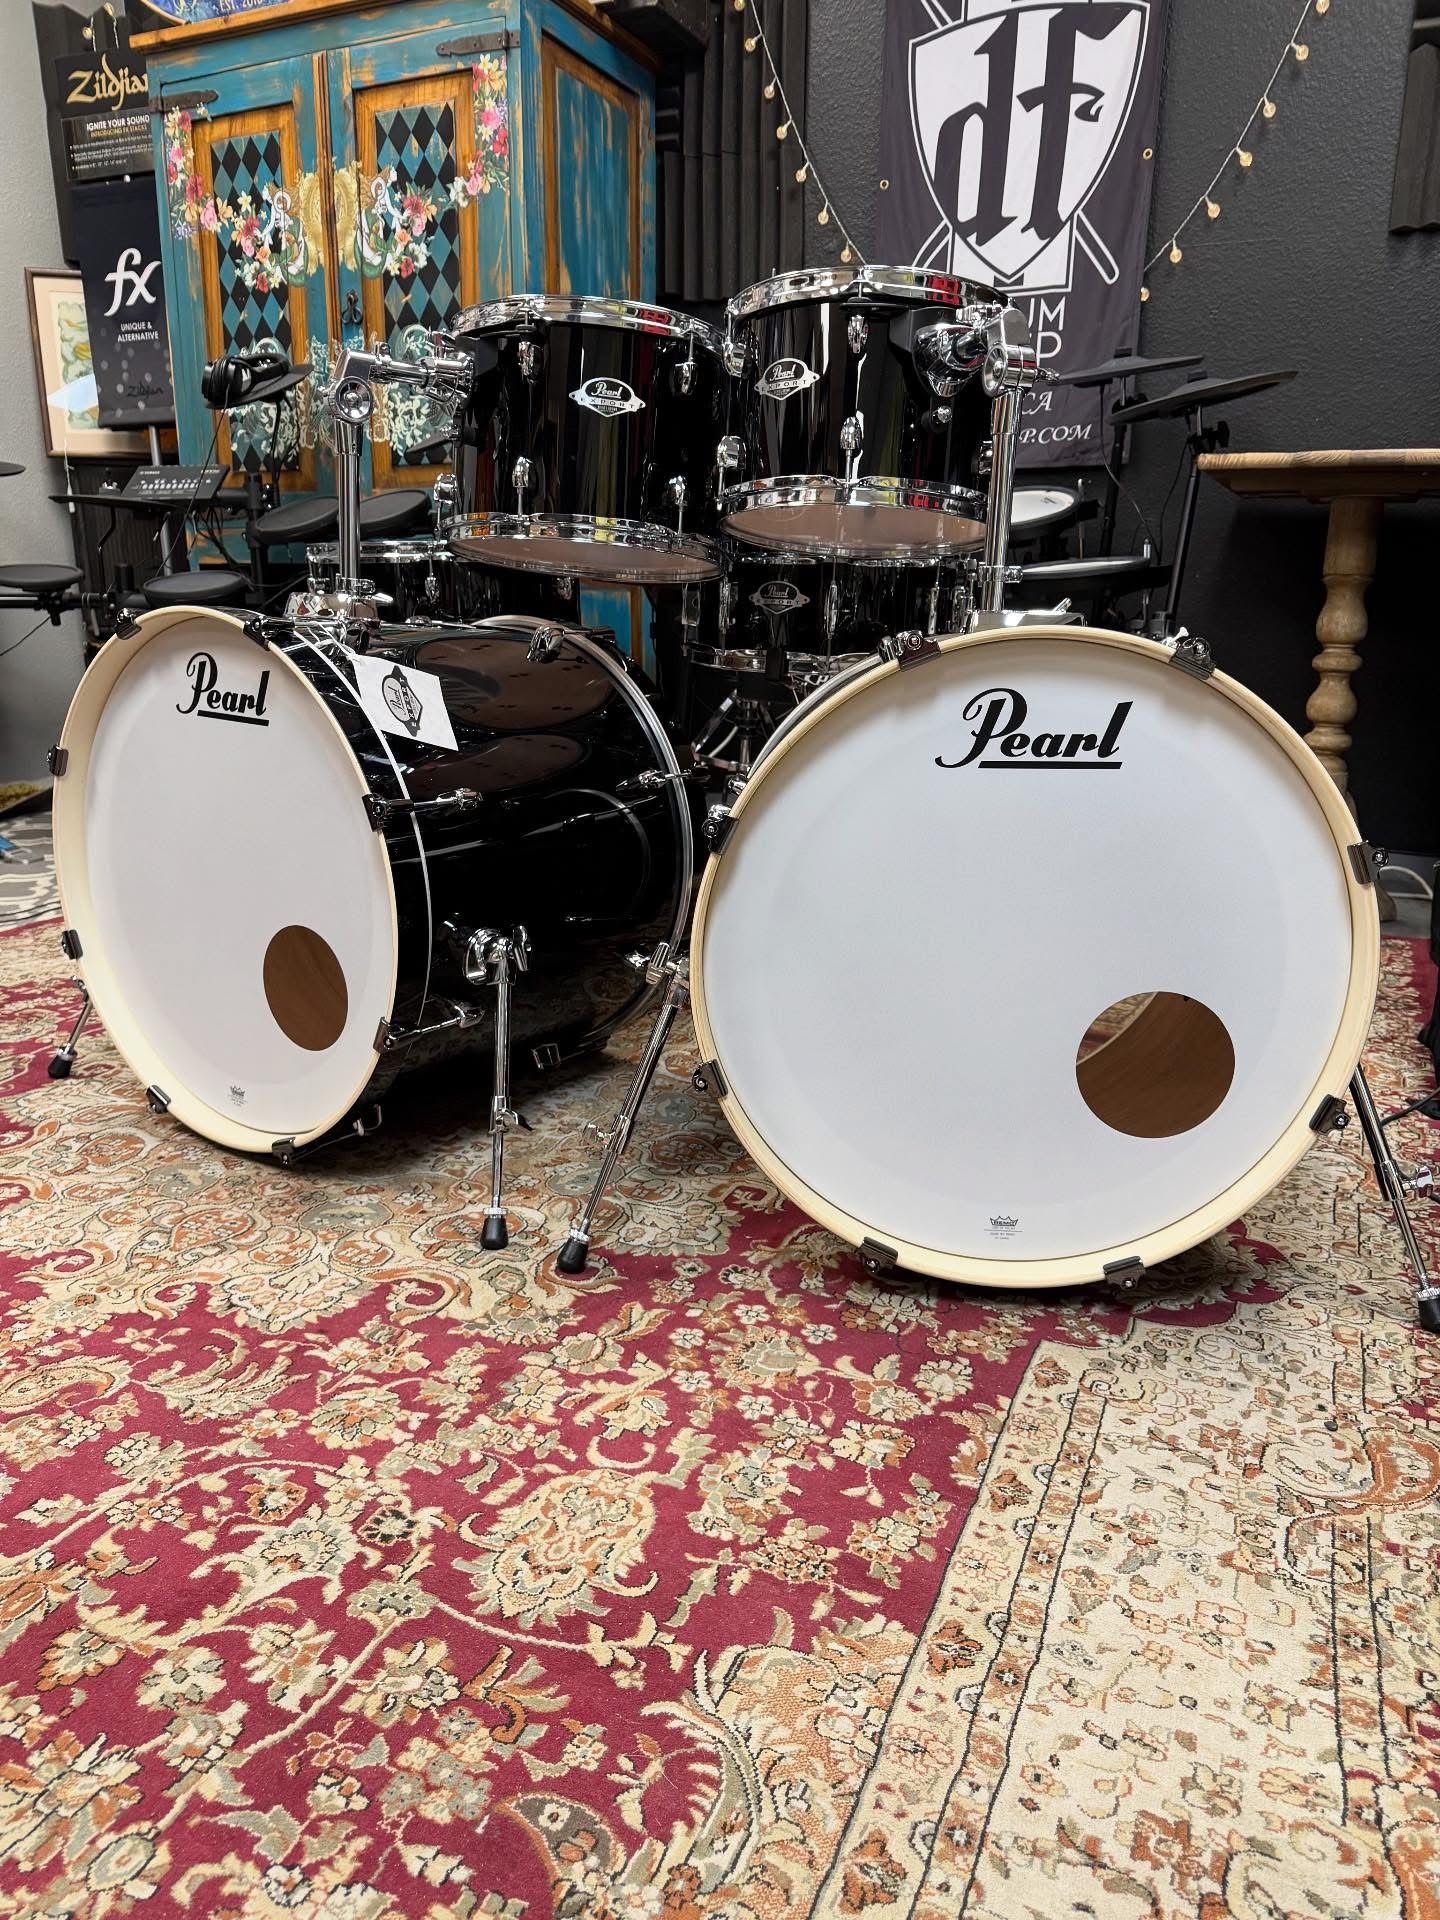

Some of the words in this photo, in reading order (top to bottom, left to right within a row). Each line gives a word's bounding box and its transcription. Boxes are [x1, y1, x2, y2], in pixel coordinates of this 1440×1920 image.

[86, 120, 107, 131] IGNITE
[107, 118, 126, 128] YOUR
[126, 114, 150, 125] SOUND
[104, 247, 161, 317] fx
[120, 322, 146, 331] UNIQUE
[117, 331, 159, 343] ALTERNATIVE
[591, 381, 623, 399] Pearl
[176, 652, 270, 726] Pearl
[934, 687, 1134, 769] Pearl
